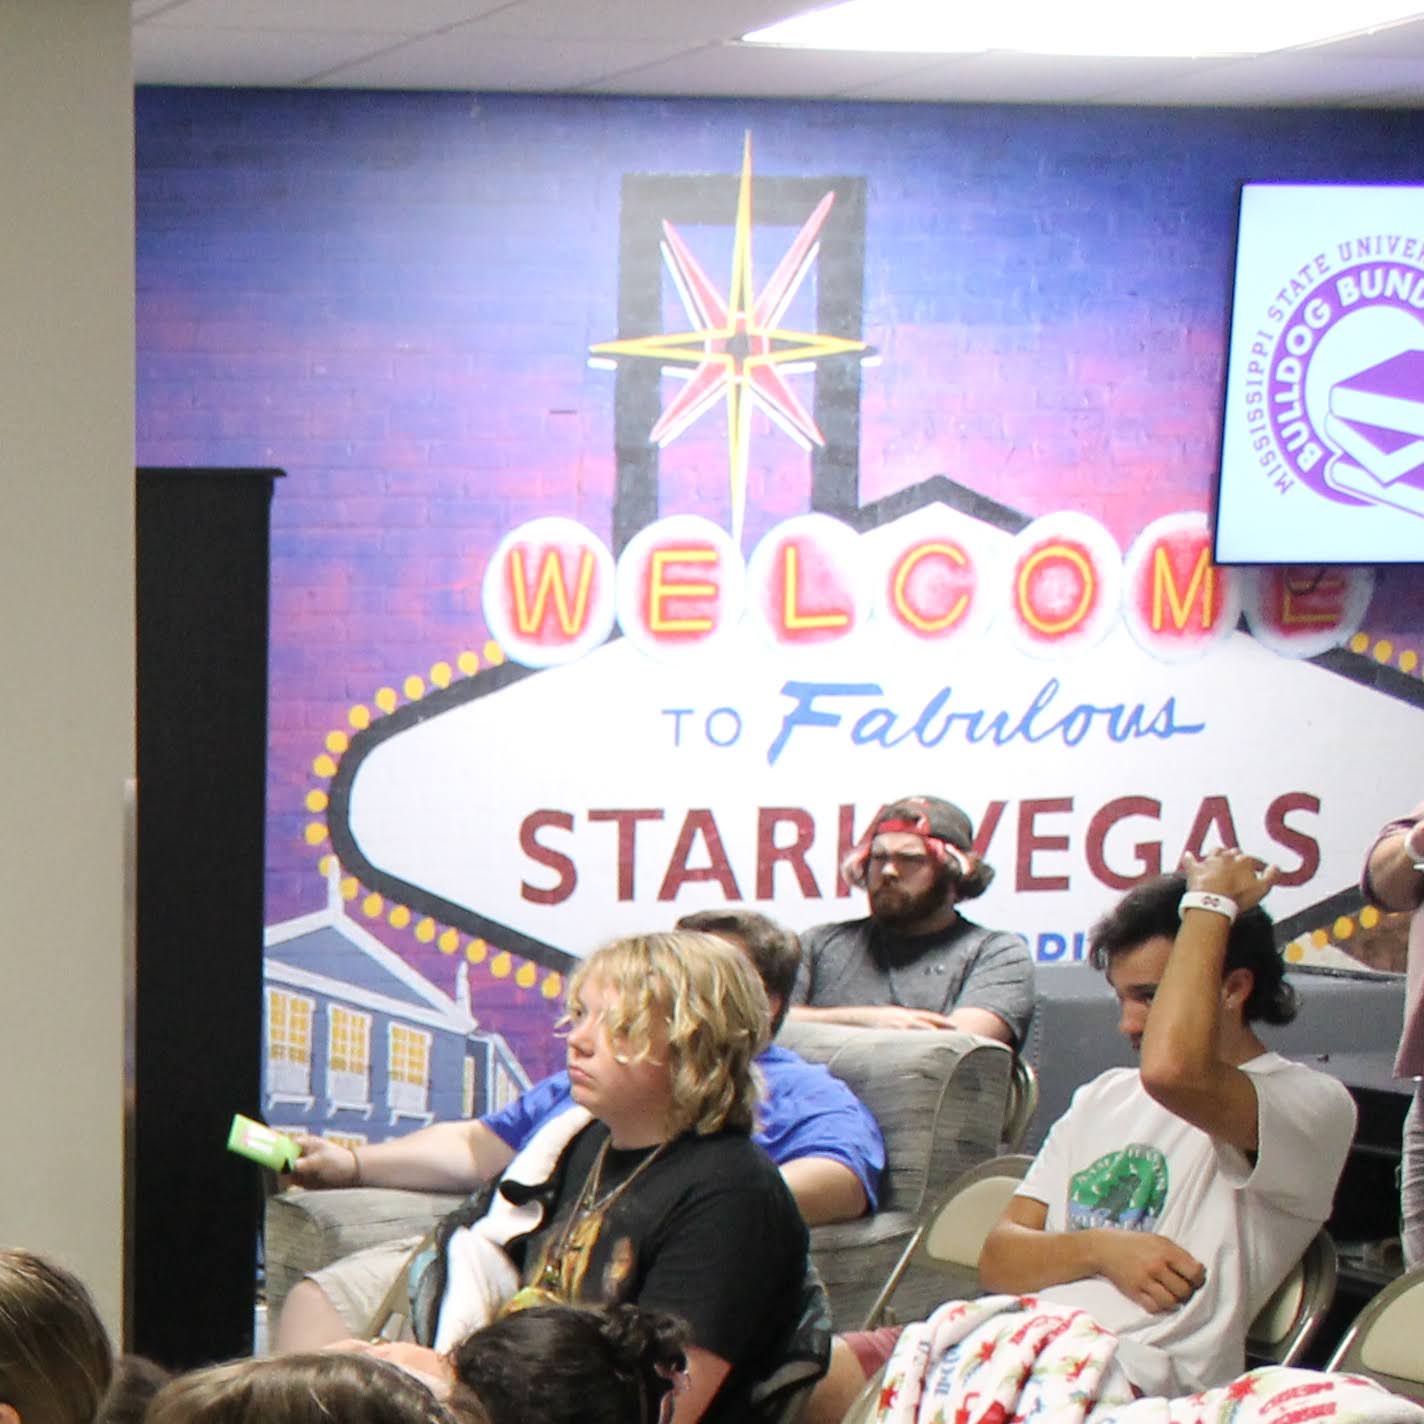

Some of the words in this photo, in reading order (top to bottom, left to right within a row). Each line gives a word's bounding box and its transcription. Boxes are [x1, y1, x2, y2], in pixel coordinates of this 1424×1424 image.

[1267, 253, 1331, 321] STATE
[1245, 330, 1295, 496] MISSISSIPPI
[1274, 297, 1331, 473] BULLDOG
[509, 543, 1345, 634] WELCOME
[660, 707, 743, 747] TO
[766, 676, 1206, 767] Fabulous
